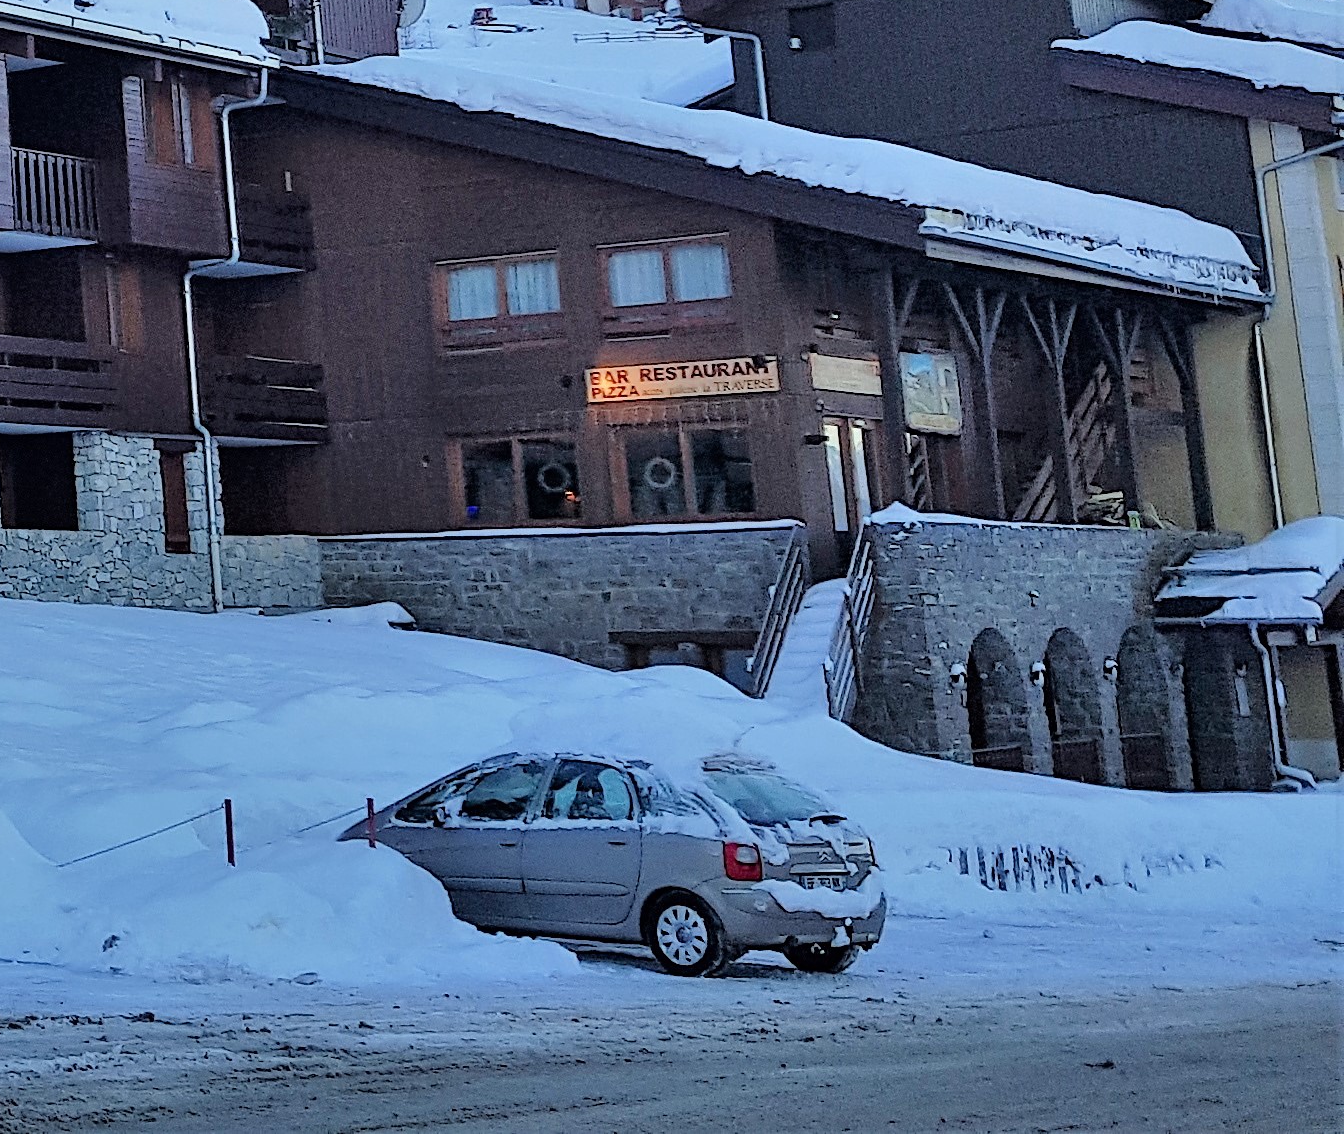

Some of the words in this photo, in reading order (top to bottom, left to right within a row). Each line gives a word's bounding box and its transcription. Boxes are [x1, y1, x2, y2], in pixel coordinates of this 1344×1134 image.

[590, 369, 630, 386] BAR
[592, 385, 641, 399] PIZZA
[713, 378, 774, 392] TRAVERSE
